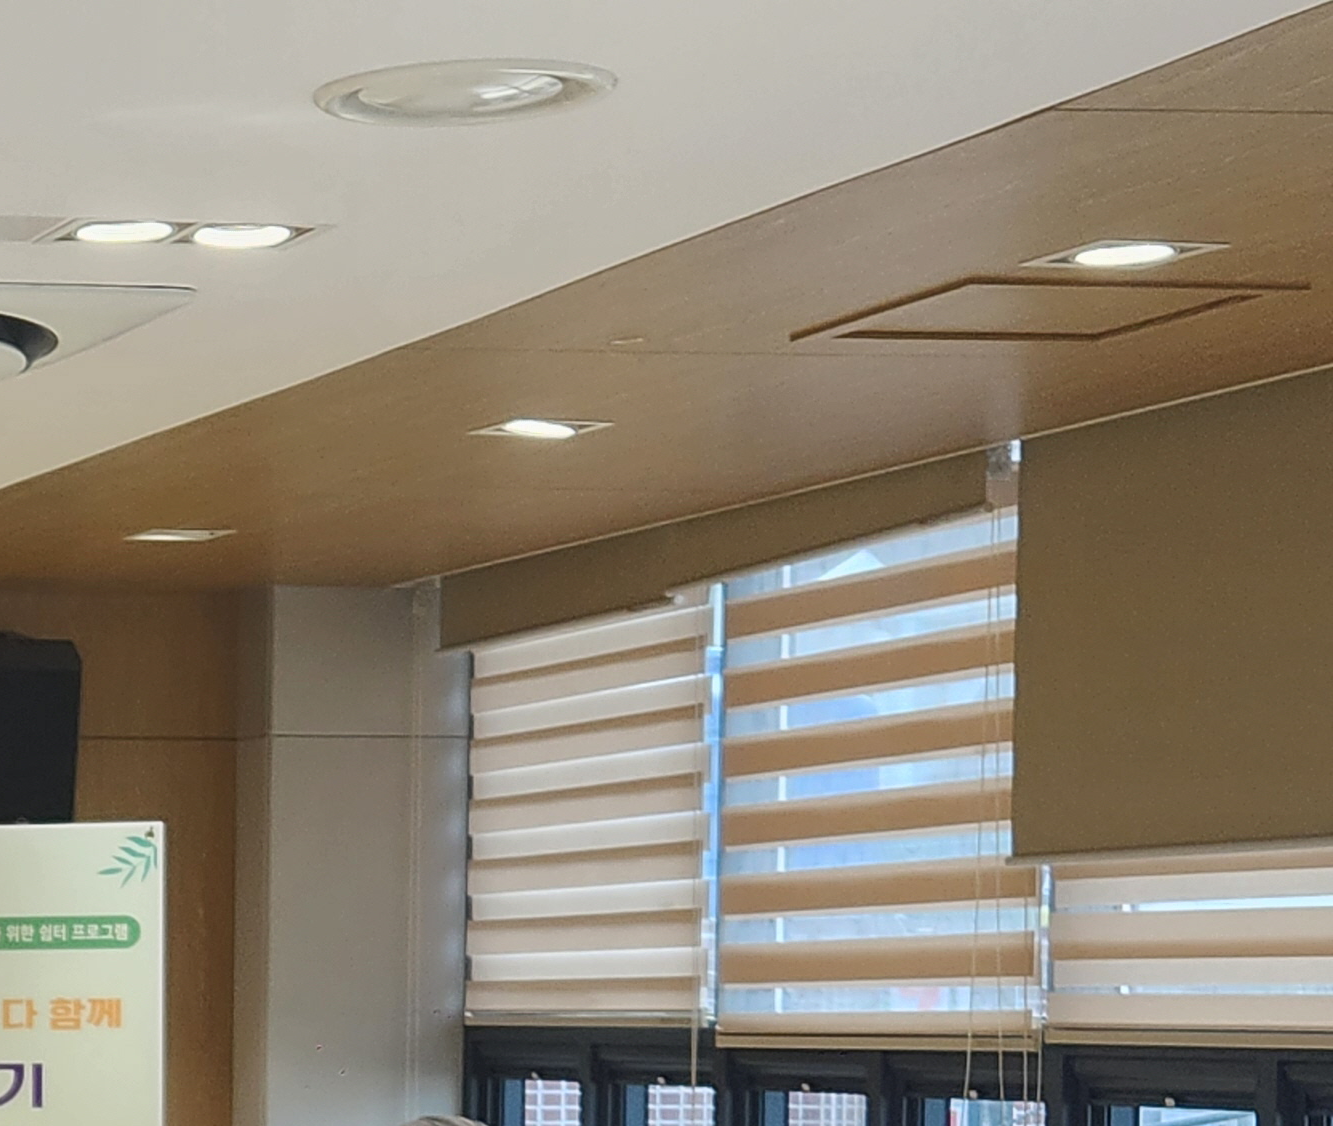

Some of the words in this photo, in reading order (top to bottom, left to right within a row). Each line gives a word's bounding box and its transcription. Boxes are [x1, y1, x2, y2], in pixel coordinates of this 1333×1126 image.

[6, 924, 34, 942] 위한
[40, 923, 66, 941] 쉼터
[71, 923, 128, 941] 프로그램
[2, 998, 38, 1029] 다
[49, 997, 122, 1030] 함께
